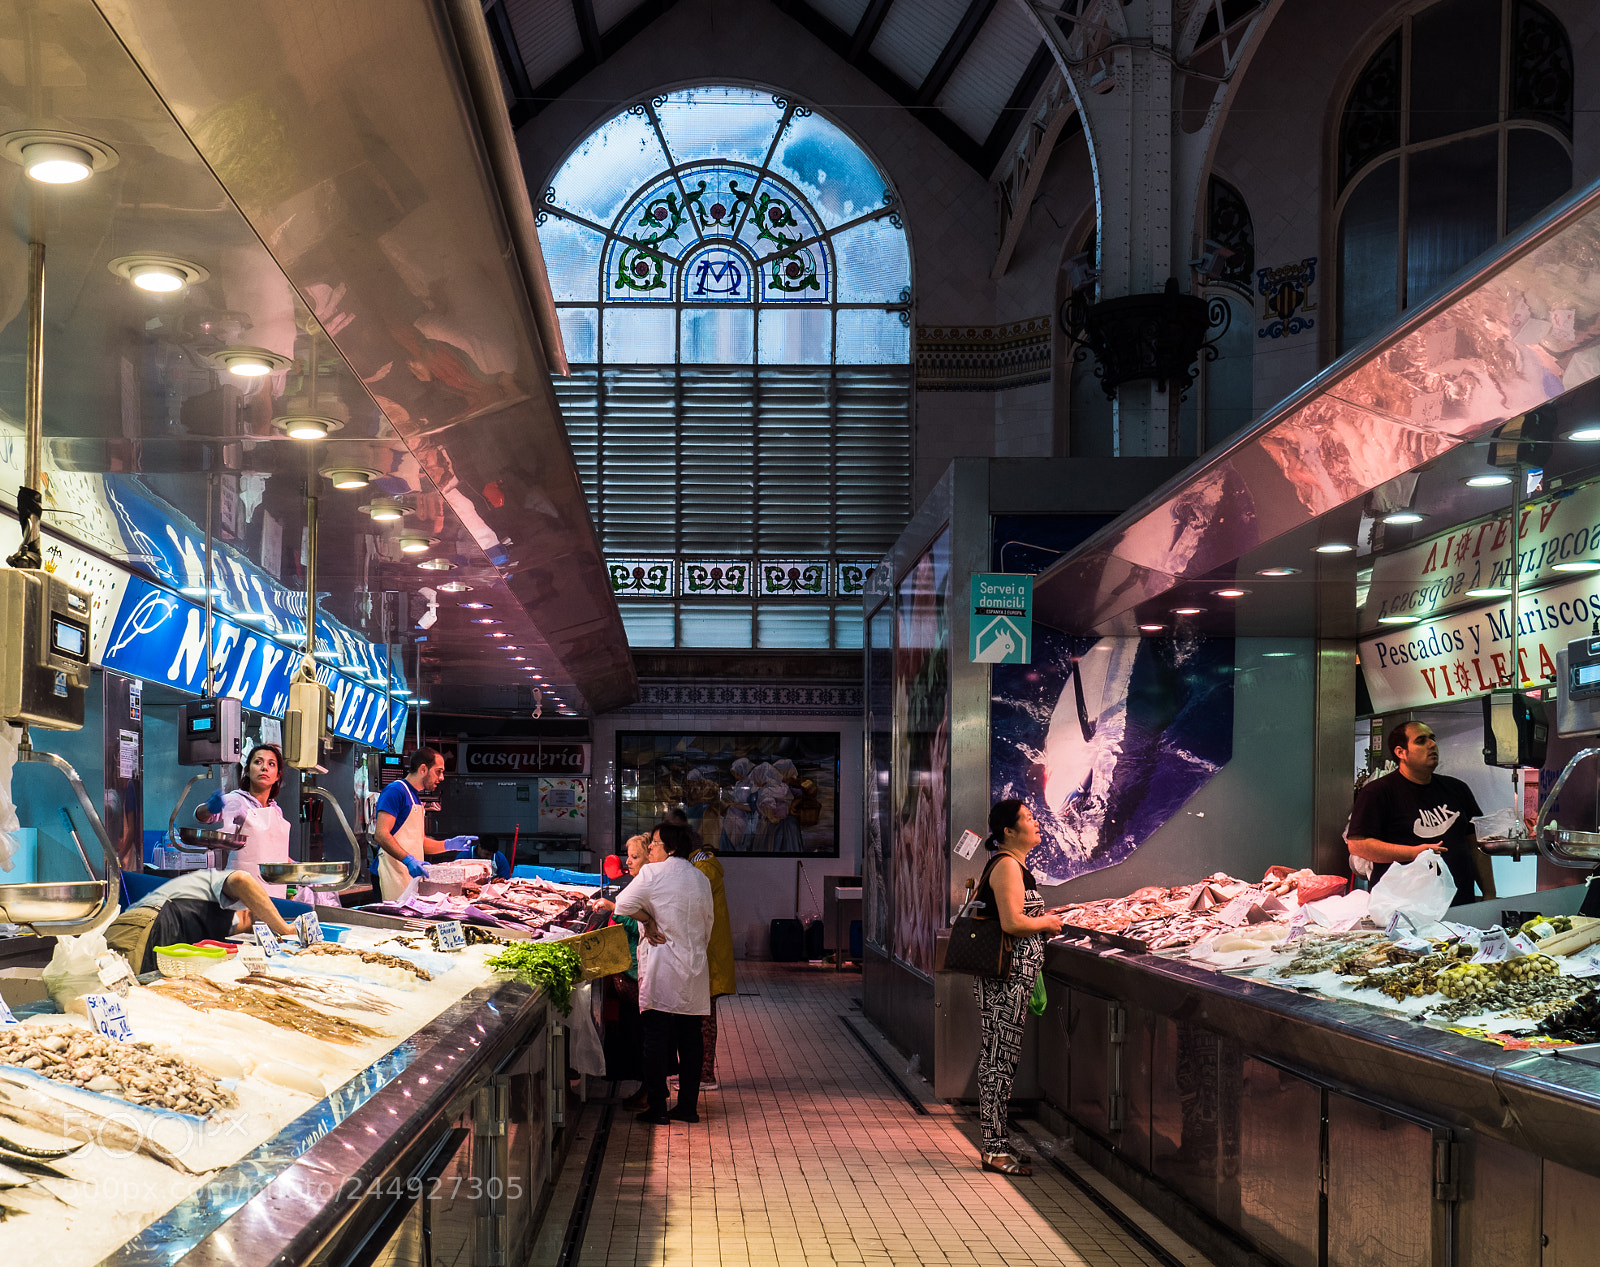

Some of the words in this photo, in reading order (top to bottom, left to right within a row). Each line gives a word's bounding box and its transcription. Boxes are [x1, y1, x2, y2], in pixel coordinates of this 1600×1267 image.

[979, 595, 1025, 608] domicili
[980, 582, 1015, 595] Servei
[1018, 586, 1025, 595] a
[1375, 627, 1464, 668] Pescados
[1468, 624, 1480, 654] y
[1485, 593, 1600, 643] Mariscos
[167, 607, 284, 706] NELY
[334, 679, 388, 743] NELY
[470, 748, 583, 769] casquería
